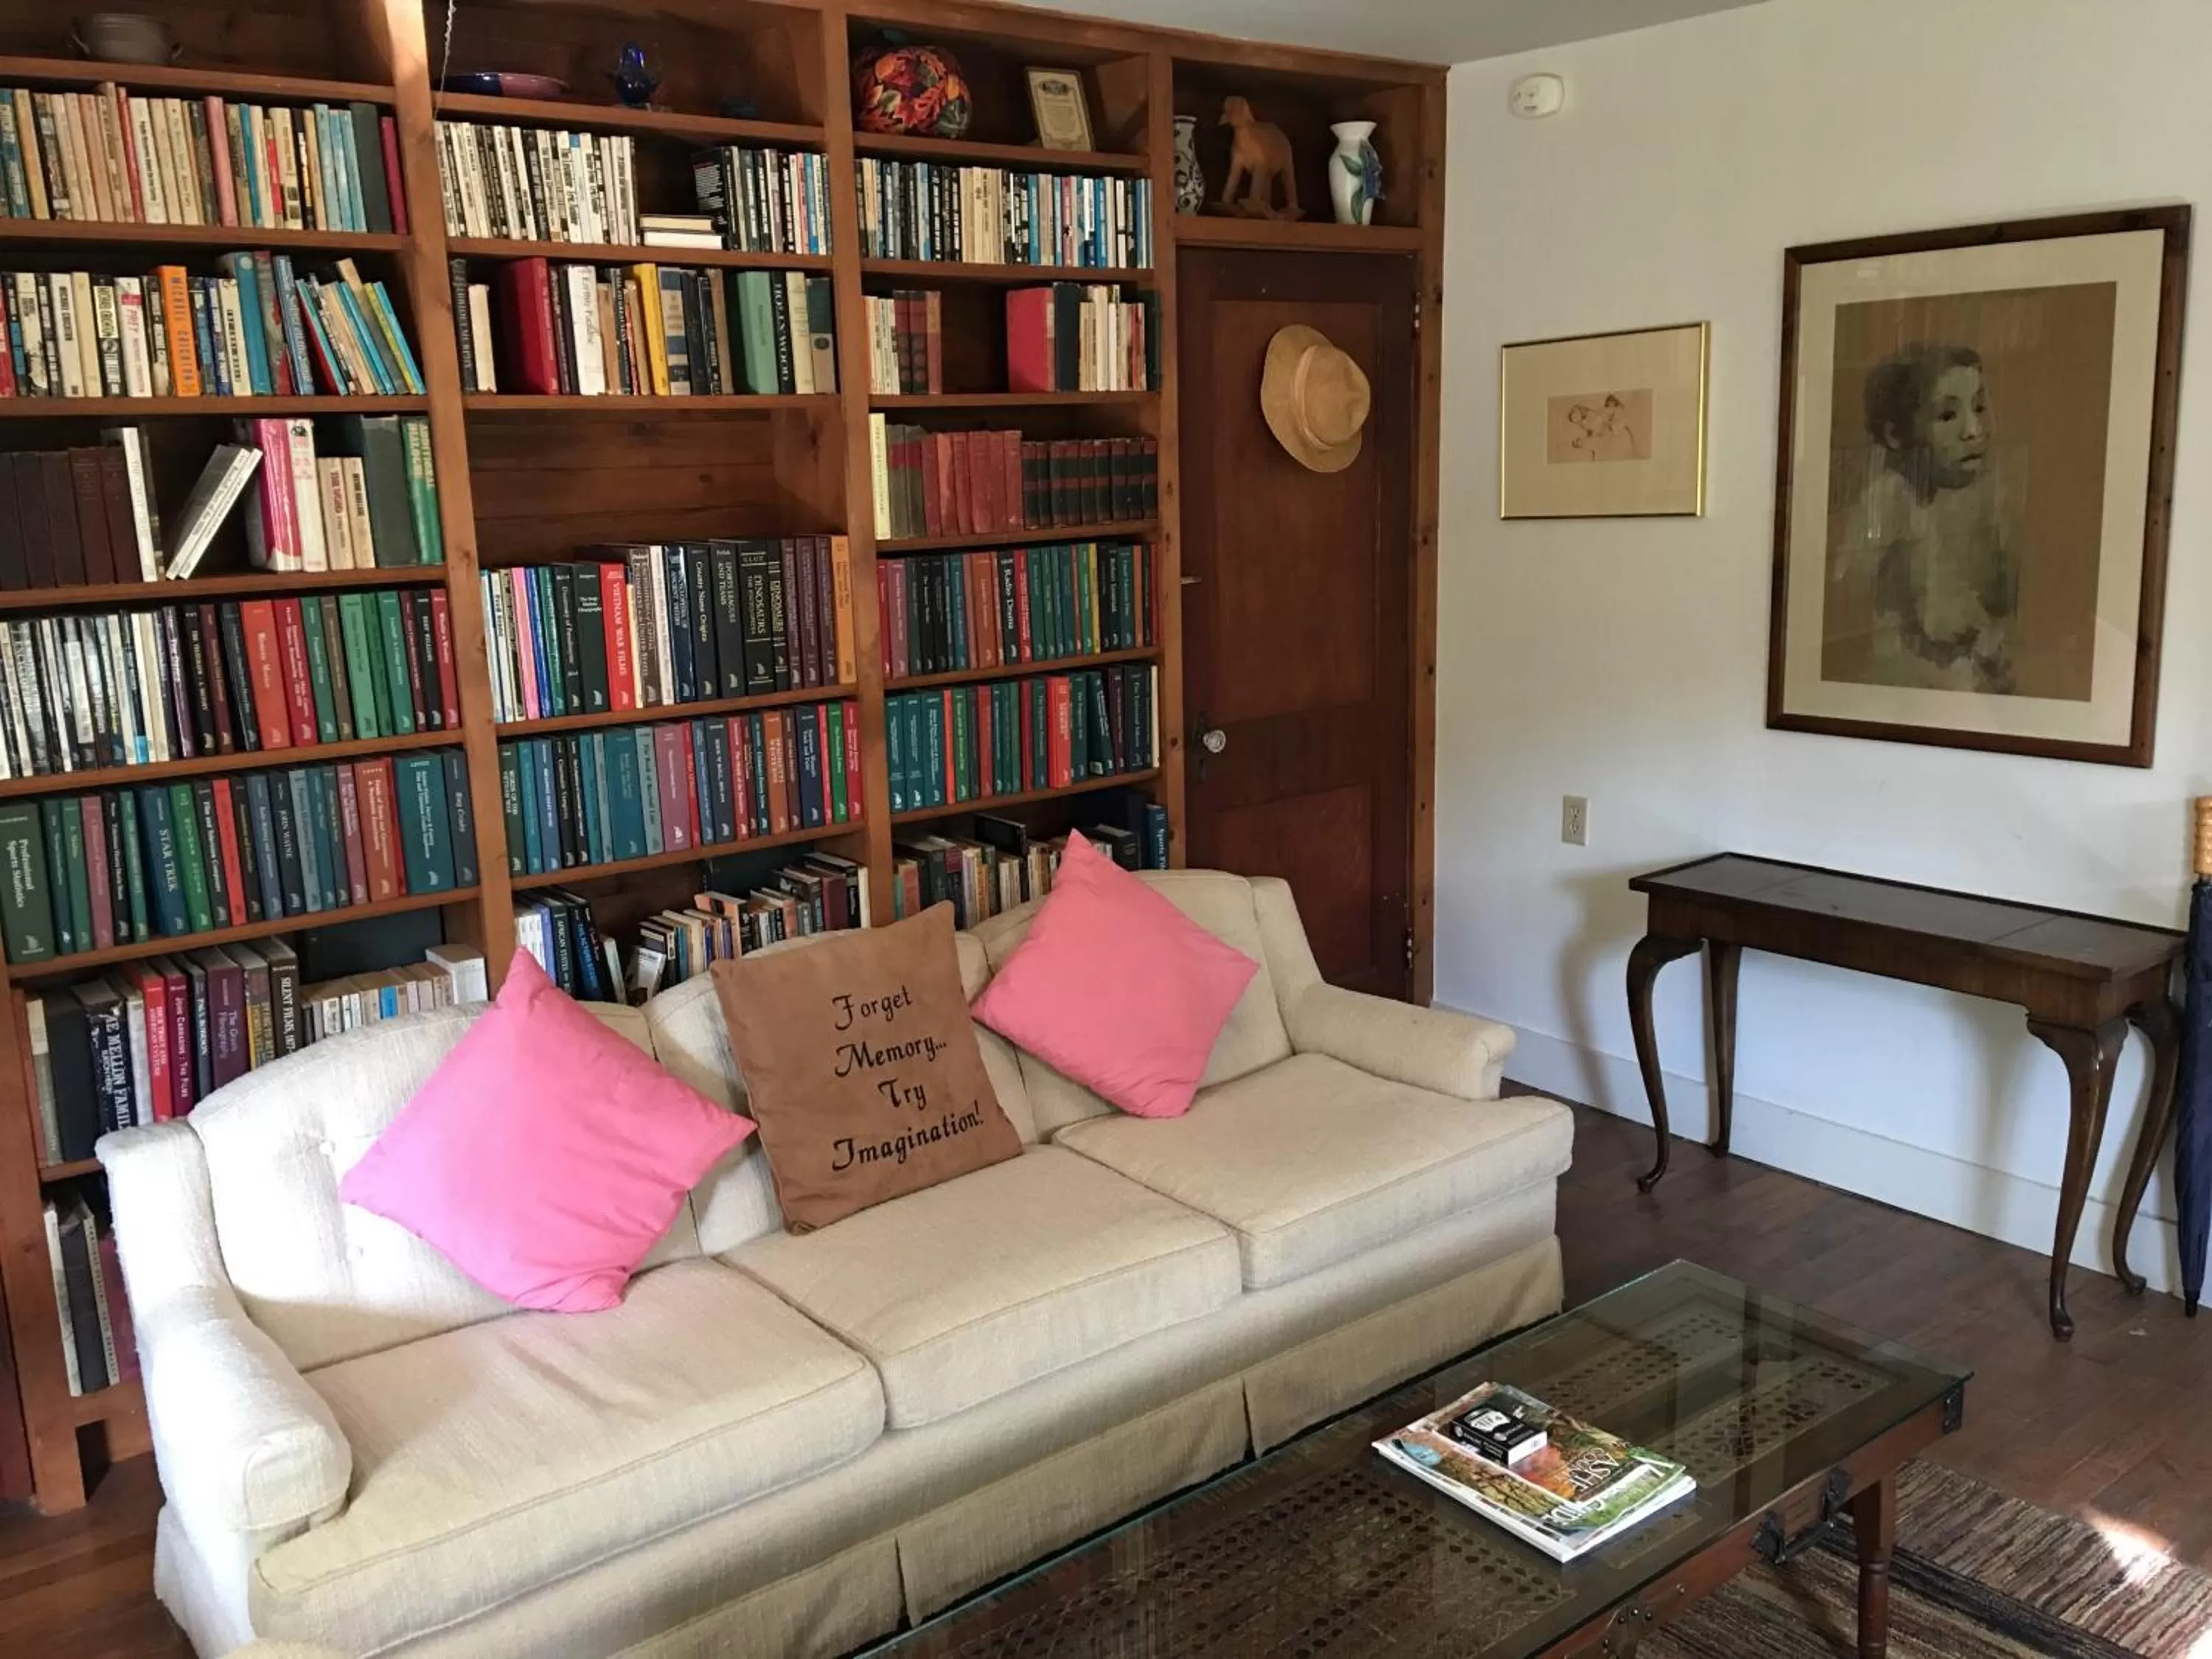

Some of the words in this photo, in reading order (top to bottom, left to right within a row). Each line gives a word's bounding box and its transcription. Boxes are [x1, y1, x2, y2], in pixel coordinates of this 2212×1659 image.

[695, 561, 704, 589] County
[1004, 568, 1012, 597] Radio
[612, 582, 623, 626] VIETNAM
[698, 591, 706, 613] Name
[754, 574, 766, 635] DINOSAURS
[1006, 599, 1015, 630] Drama
[615, 627, 624, 647] WAR
[618, 650, 627, 676] FILMS
[277, 810, 289, 830] JOHN
[6, 840, 20, 869] Sports
[159, 828, 173, 859] STAR
[282, 832, 292, 860] WAYNE
[18, 838, 35, 890] Professional
[165, 861, 178, 892] TREK
[11, 870, 26, 908] Statistics
[557, 920, 567, 947] AFRICAN
[581, 938, 591, 962] ACTORS
[281, 977, 292, 1005] SILENT
[175, 997, 184, 1015] JOHN
[196, 998, 204, 1018] PAUL
[229, 1011, 237, 1027] The
[282, 1007, 295, 1034] FILMS,
[832, 985, 913, 1031] Forget
[177, 1017, 187, 1054] CARRADINE
[199, 1019, 207, 1056] ROBESON
[107, 1034, 125, 1085] MELLON
[179, 1062, 187, 1077] THE
[835, 1035, 947, 1077] Memory...
[180, 1077, 189, 1098] FILMS
[878, 1077, 928, 1110] Try
[114, 1088, 131, 1130] FAMIL
[832, 1101, 984, 1172] Imagination!
